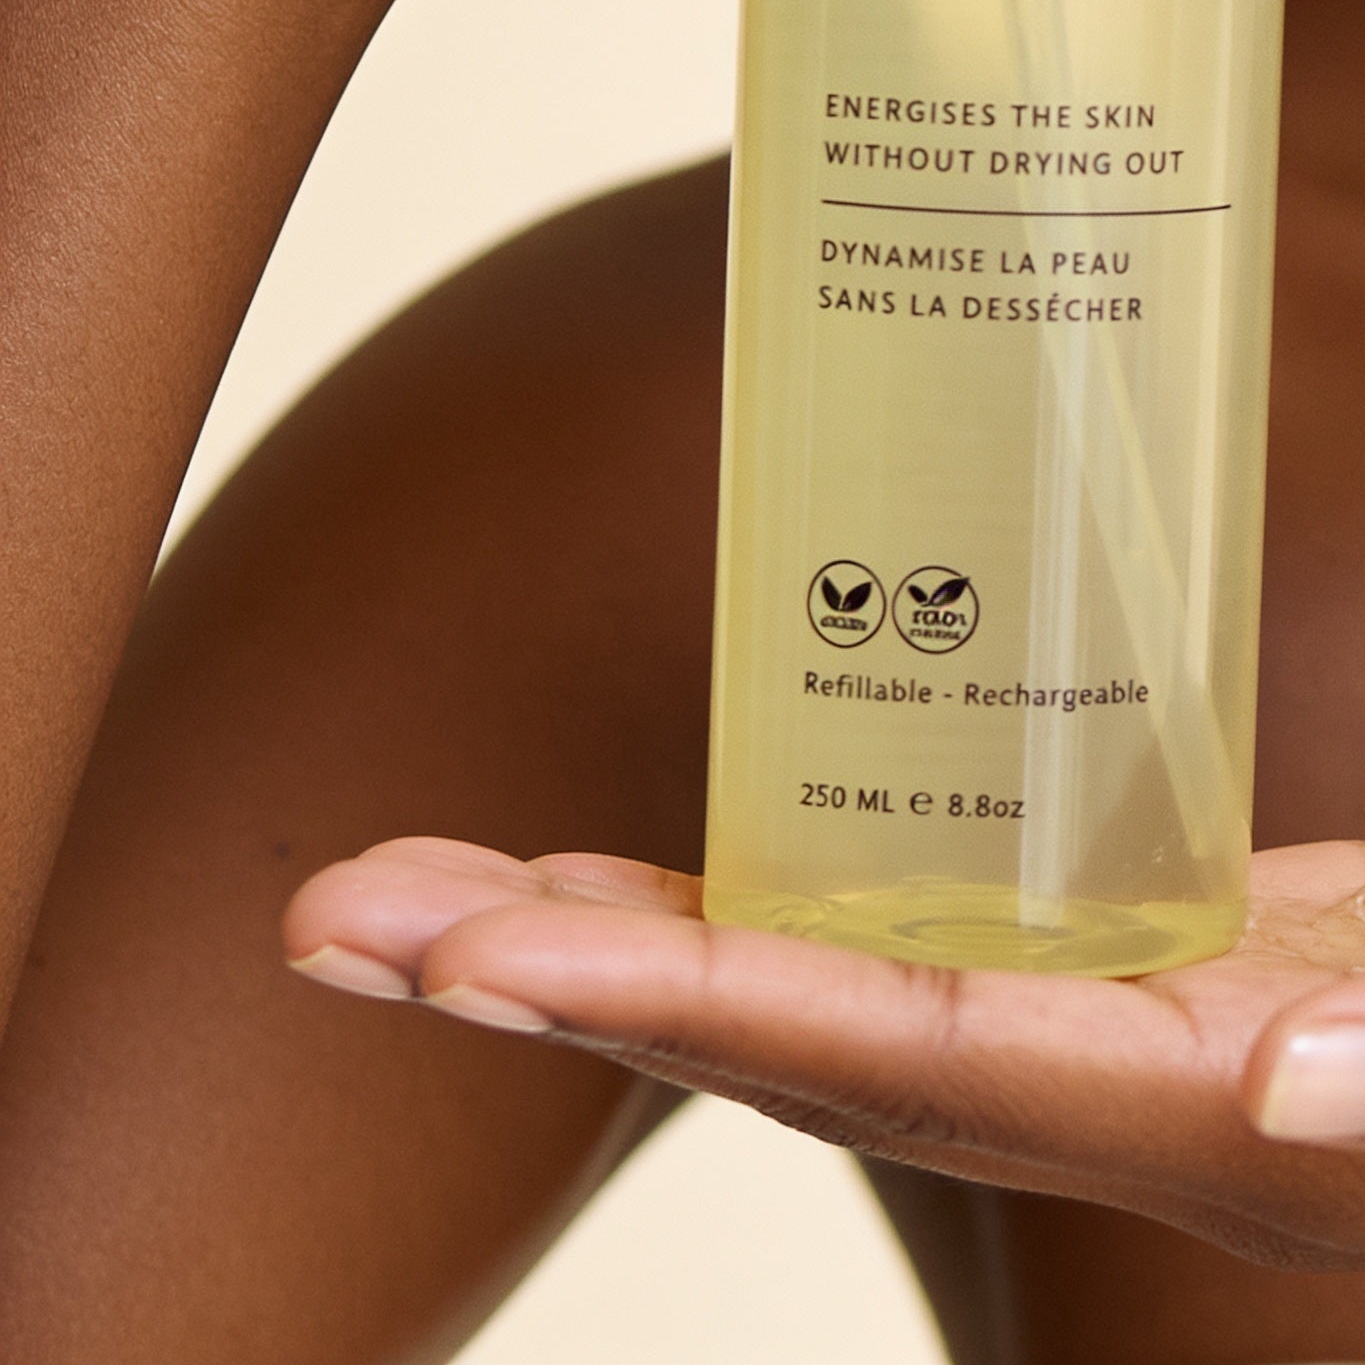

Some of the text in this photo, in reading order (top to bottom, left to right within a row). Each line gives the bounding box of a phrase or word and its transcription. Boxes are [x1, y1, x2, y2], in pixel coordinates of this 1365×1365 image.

[824, 93, 1155, 129] ENERGISES THE SKIN
[824, 140, 1185, 175] WITHOUT DRYING OUT
[820, 239, 1130, 275] DYNAMISE LA PEAU
[818, 285, 1143, 322] SANS LA DESSÉCHER
[803, 671, 933, 704] Refillable
[963, 679, 1150, 712] Rechargeable
[799, 783, 847, 810] 250
[857, 788, 895, 814] ML
[947, 794, 1027, 819] 8.8oz
